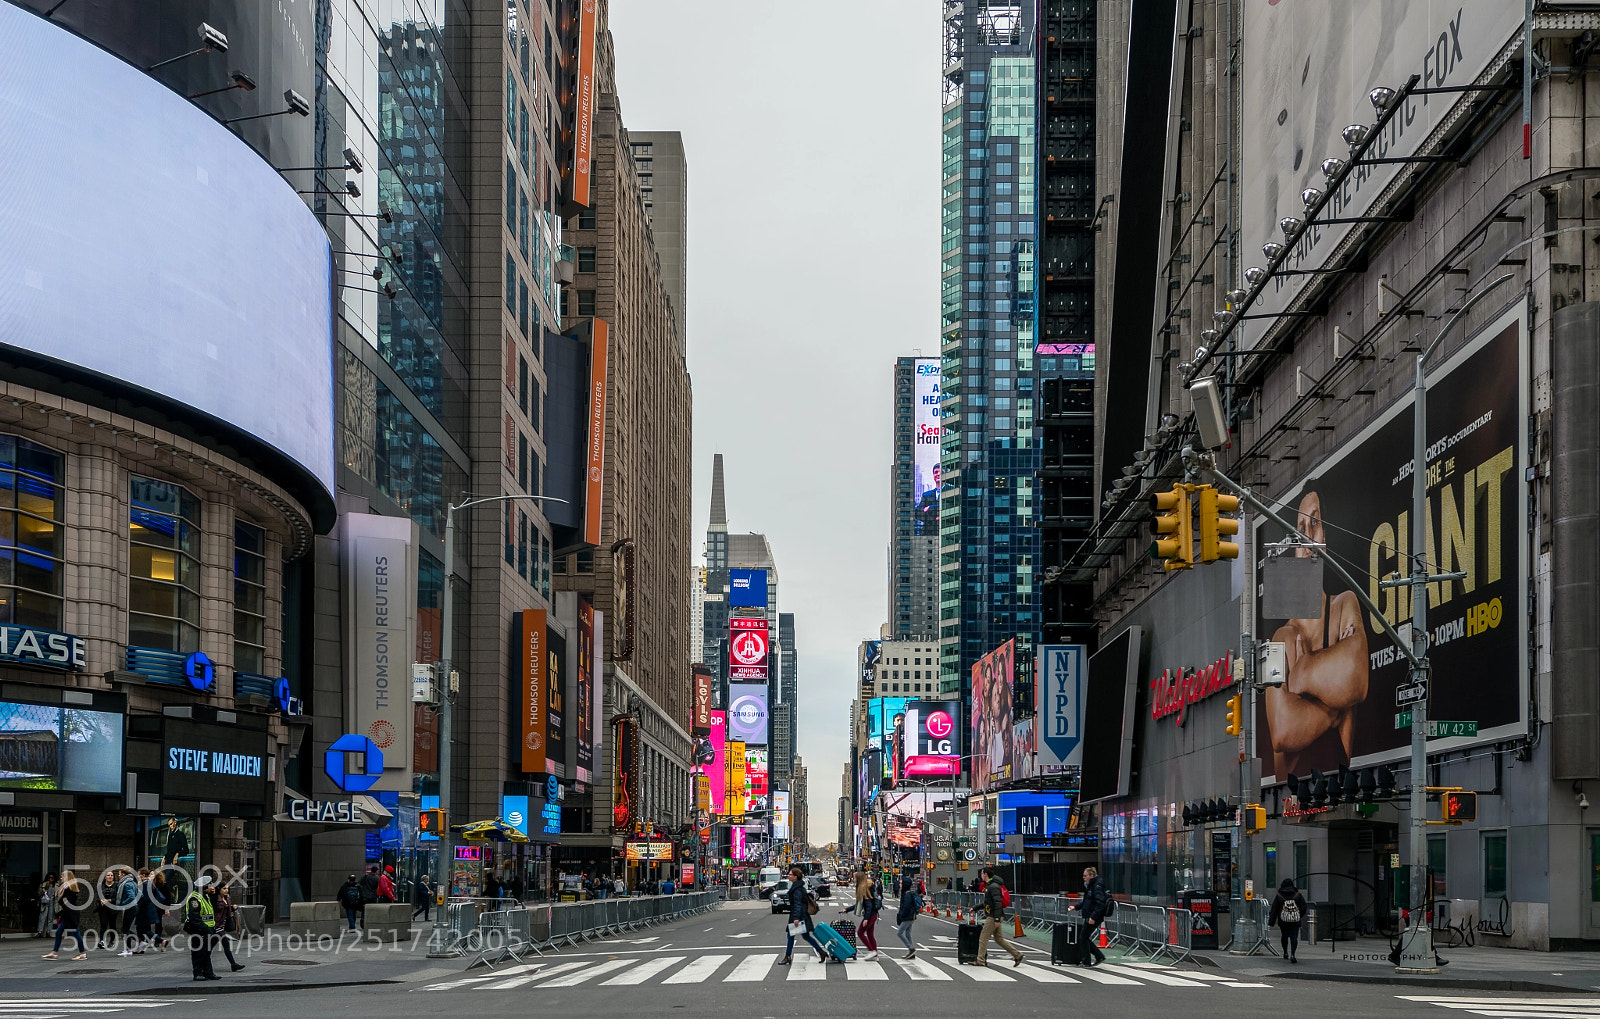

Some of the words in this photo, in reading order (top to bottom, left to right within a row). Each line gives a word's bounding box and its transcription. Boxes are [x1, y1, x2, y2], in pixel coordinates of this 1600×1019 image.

[1423, 7, 1463, 107] FOX
[582, 74, 590, 112] REUTERS
[580, 112, 588, 154] THOMSON
[592, 420, 600, 462] THOMSON
[1398, 459, 1415, 482] HBO
[1447, 410, 1493, 449] DOCUMENTARY
[1444, 456, 1456, 476] THE
[376, 555, 388, 628] REUTERS
[530, 631, 539, 675] REUTERS
[1370, 645, 1394, 670] TUES
[1434, 617, 1465, 648] 10PM
[1466, 596, 1503, 638] HBO
[376, 631, 388, 711] THOMSON
[530, 676, 538, 726] THOMSON
[1055, 651, 1069, 736] NYPD
[1400, 690, 1410, 699] ONE
[1412, 687, 1424, 696] WAY
[927, 739, 952, 755] LG
[1439, 723, 1449, 735] W
[1452, 723, 1464, 735] 42
[1468, 723, 1476, 732] St
[168, 747, 208, 773] STEVE
[212, 752, 261, 777] MADDEN
[0, 816, 39, 828] MADDEN
[289, 799, 364, 824] CHASE
[1021, 816, 1039, 835] GAP
